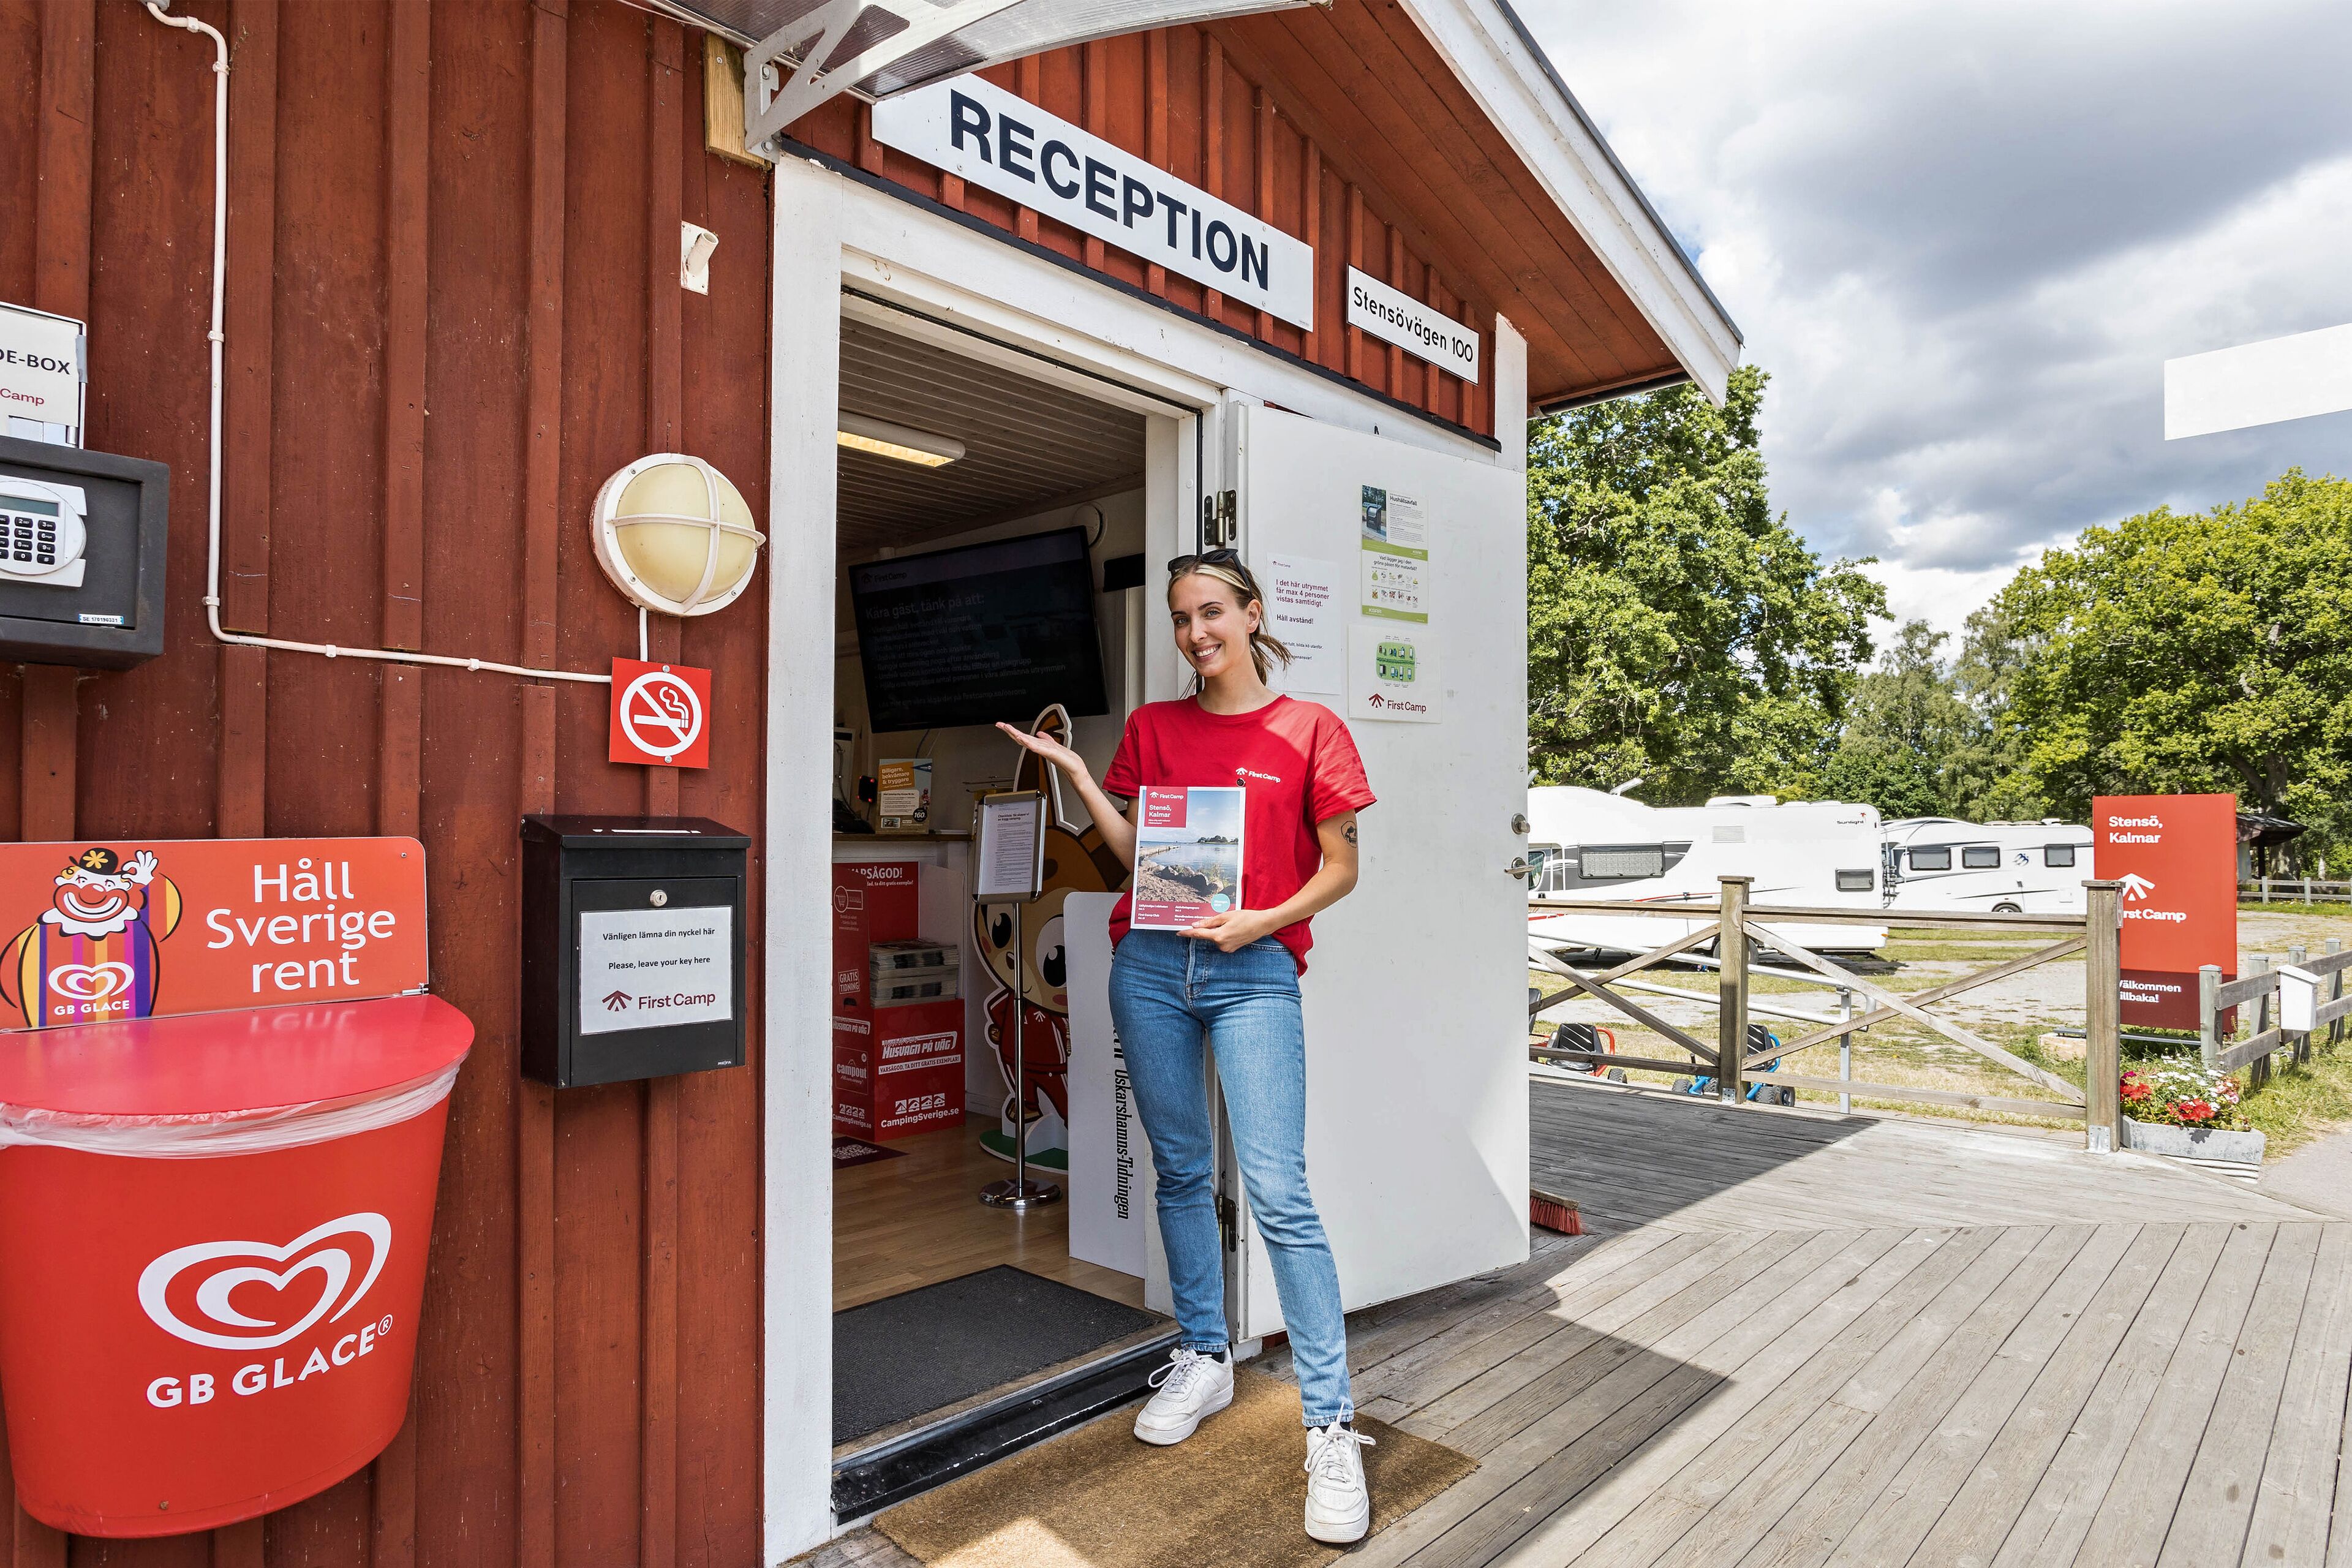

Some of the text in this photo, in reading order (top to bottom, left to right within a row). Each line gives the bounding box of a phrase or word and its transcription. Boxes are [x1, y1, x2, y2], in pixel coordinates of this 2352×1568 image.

[951, 88, 1268, 291] RECEPTION
[1354, 286, 1473, 363] Stensövägen 100
[0, 388, 45, 406] Camp
[1302, 583, 1328, 592] utrymmet
[1295, 598, 1323, 607] samtidigt.
[1289, 616, 1314, 624] avstånd!
[1387, 700, 1427, 714] First Camp
[1263, 774, 1281, 783] Camp
[2109, 815, 2163, 829] Stensö,
[2109, 832, 2161, 843] Kalmar
[254, 858, 354, 903] Håll
[2123, 908, 2186, 923] rst Camp
[206, 904, 396, 951] Sverige
[603, 931, 637, 941] Vänligen
[679, 929, 701, 938] nyckel
[660, 959, 677, 967] your
[679, 957, 692, 966] key
[252, 951, 360, 993] rent
[840, 971, 858, 983] GRATIS
[840, 982, 859, 992] TIDNING
[638, 993, 715, 1009] First Camp
[2120, 992, 2159, 1003] illbaka!
[54, 1000, 130, 1017] GB GLACE
[922, 1040, 933, 1054] PÅ
[935, 1038, 951, 1052] VÄG
[937, 1056, 959, 1065] EXEMPLAR!
[837, 1063, 867, 1079] campout
[881, 1108, 959, 1128] CampingSverige.se
[146, 1374, 214, 1408] GB
